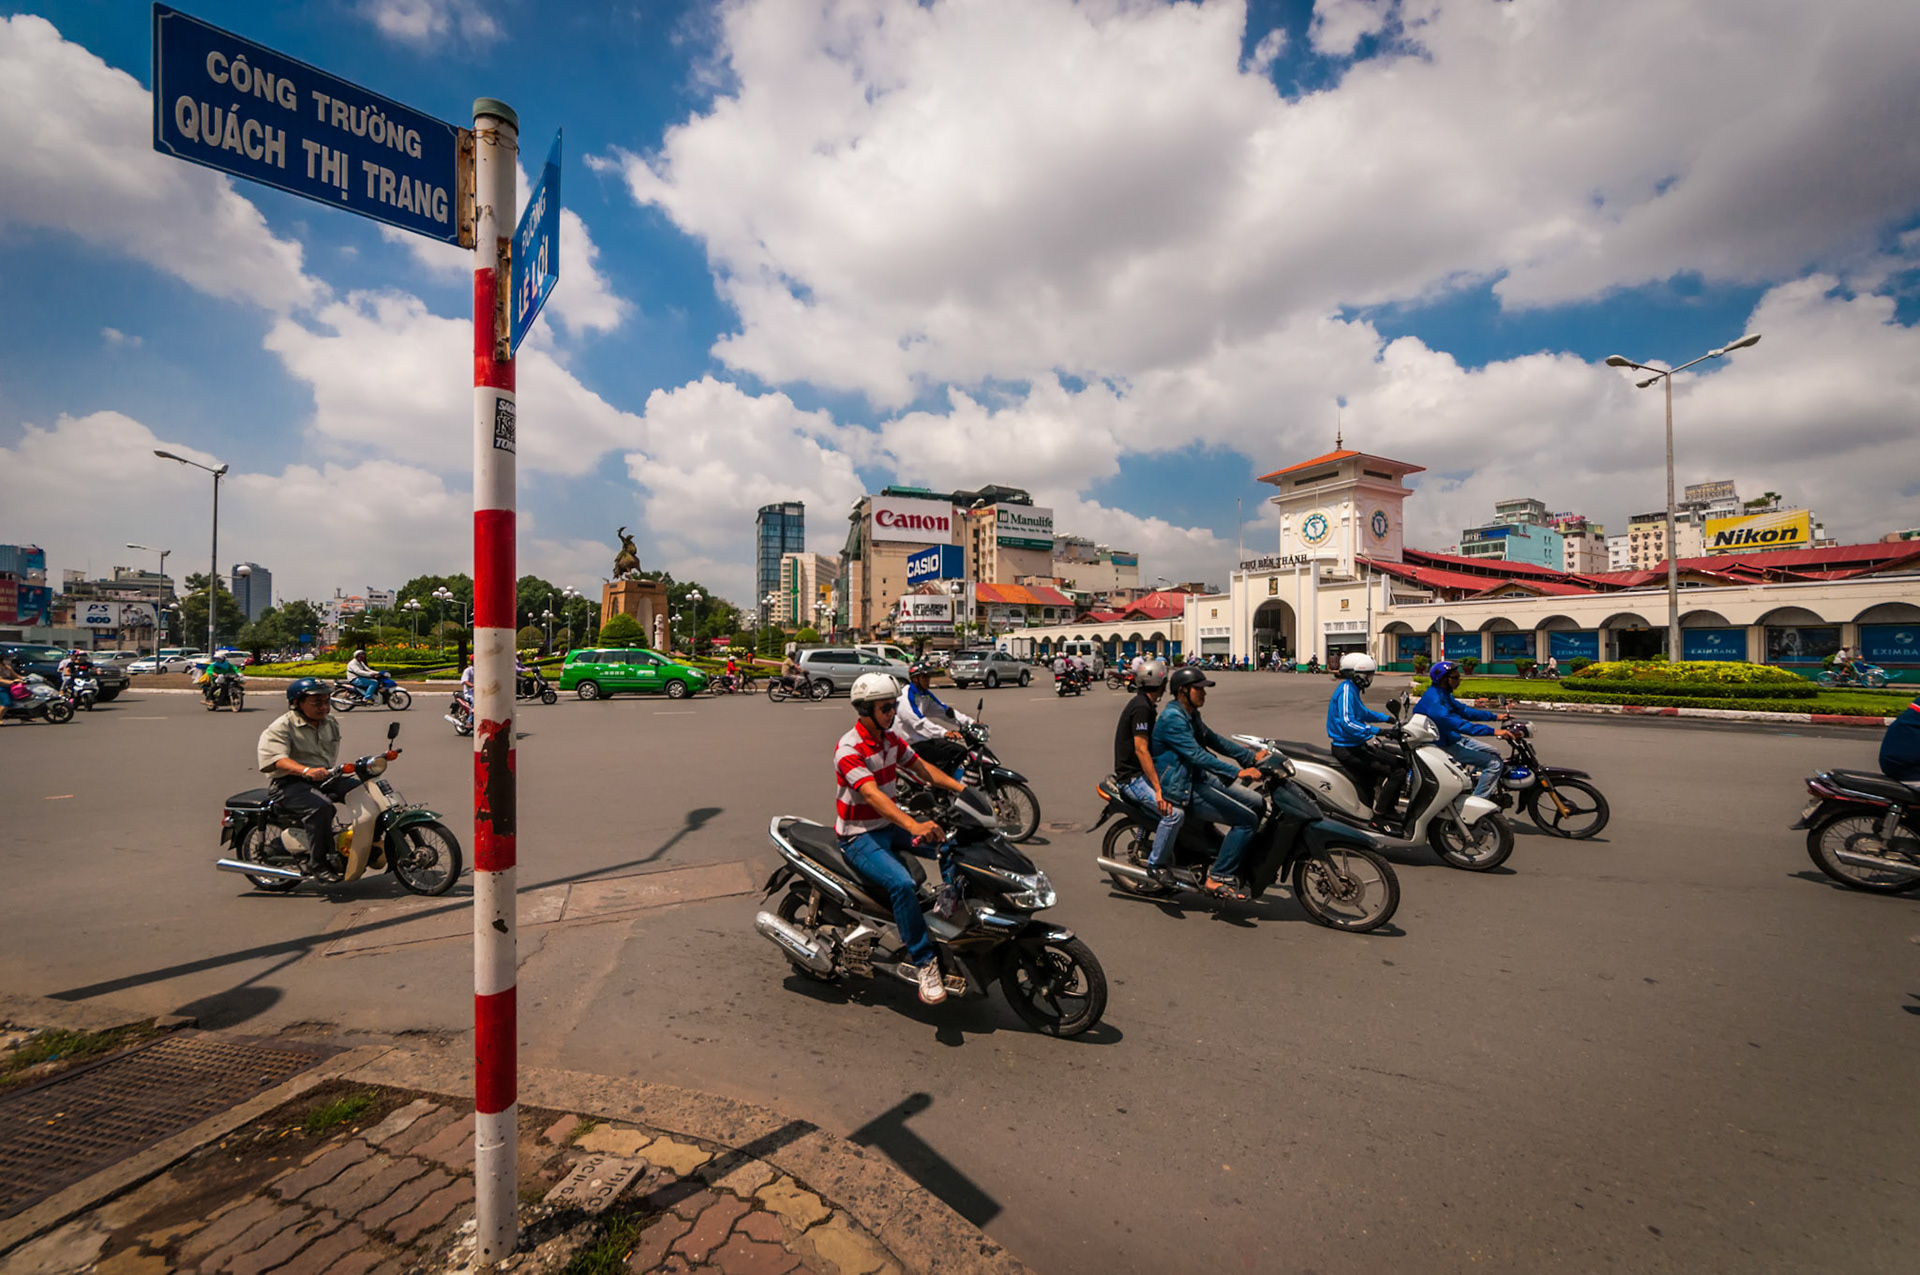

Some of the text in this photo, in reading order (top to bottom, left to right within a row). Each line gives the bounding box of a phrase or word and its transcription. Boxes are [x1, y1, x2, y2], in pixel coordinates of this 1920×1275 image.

[206, 51, 422, 159] CÔNG TRƯỜNG
[175, 95, 448, 224] QUÁCH THỊ TRANG
[518, 266, 530, 323] LÊ
[875, 509, 949, 531] Canon
[1010, 513, 1053, 527] Manulife
[1714, 526, 1799, 546] Nikon
[907, 553, 939, 578] CASIO
